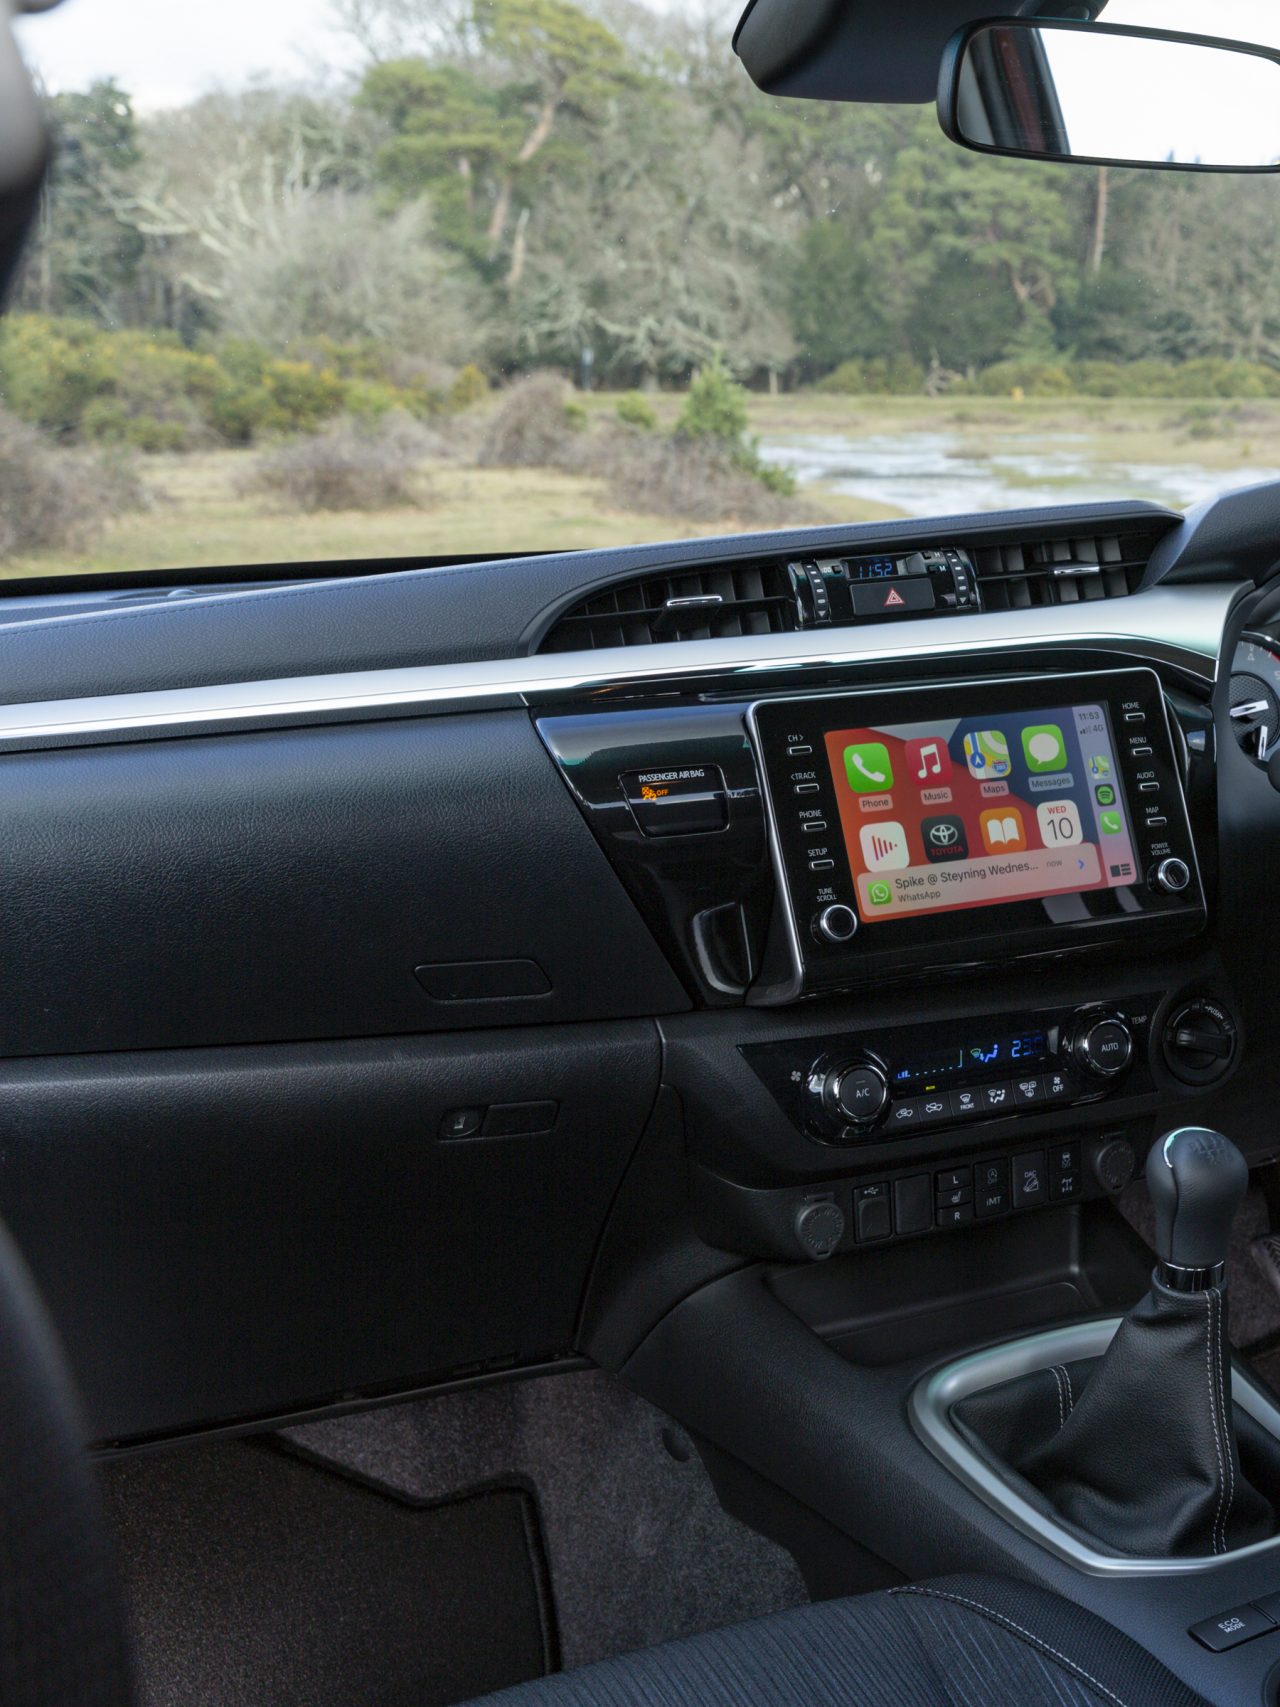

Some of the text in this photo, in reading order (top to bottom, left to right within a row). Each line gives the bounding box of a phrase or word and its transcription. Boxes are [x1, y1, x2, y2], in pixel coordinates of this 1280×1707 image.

[1122, 702, 1140, 710] HOME
[1079, 712, 1099, 721] 11:53
[639, 773, 678, 783] PASSENGER
[795, 772, 816, 780] TRACK
[1032, 777, 1071, 788] Messages
[984, 785, 1006, 794] Maps
[924, 791, 949, 801] Music
[862, 799, 889, 808] Phone
[799, 810, 822, 818] PHONE
[1047, 806, 1067, 815] WED
[1047, 817, 1073, 840] 10
[808, 848, 827, 857] SETUP
[931, 846, 963, 856] TOYOTA
[1046, 859, 1063, 868] now
[895, 876, 924, 890] Spike
[928, 874, 938, 885] @
[941, 868, 987, 883] Steyning
[818, 887, 833, 895] TUNE
[897, 891, 941, 903] WhatsApp
[1132, 1016, 1148, 1025] TEMP
[1102, 1042, 1119, 1052] AUTO
[856, 1088, 870, 1098] A/C
[1053, 1084, 1064, 1093] OFF
[960, 1102, 975, 1110] FRONT
[1024, 1170, 1036, 1178] DAC
[953, 1176, 958, 1184] L
[954, 1211, 960, 1220] R
[1218, 1617, 1240, 1629] ECO
[1224, 1621, 1246, 1633] MODE
